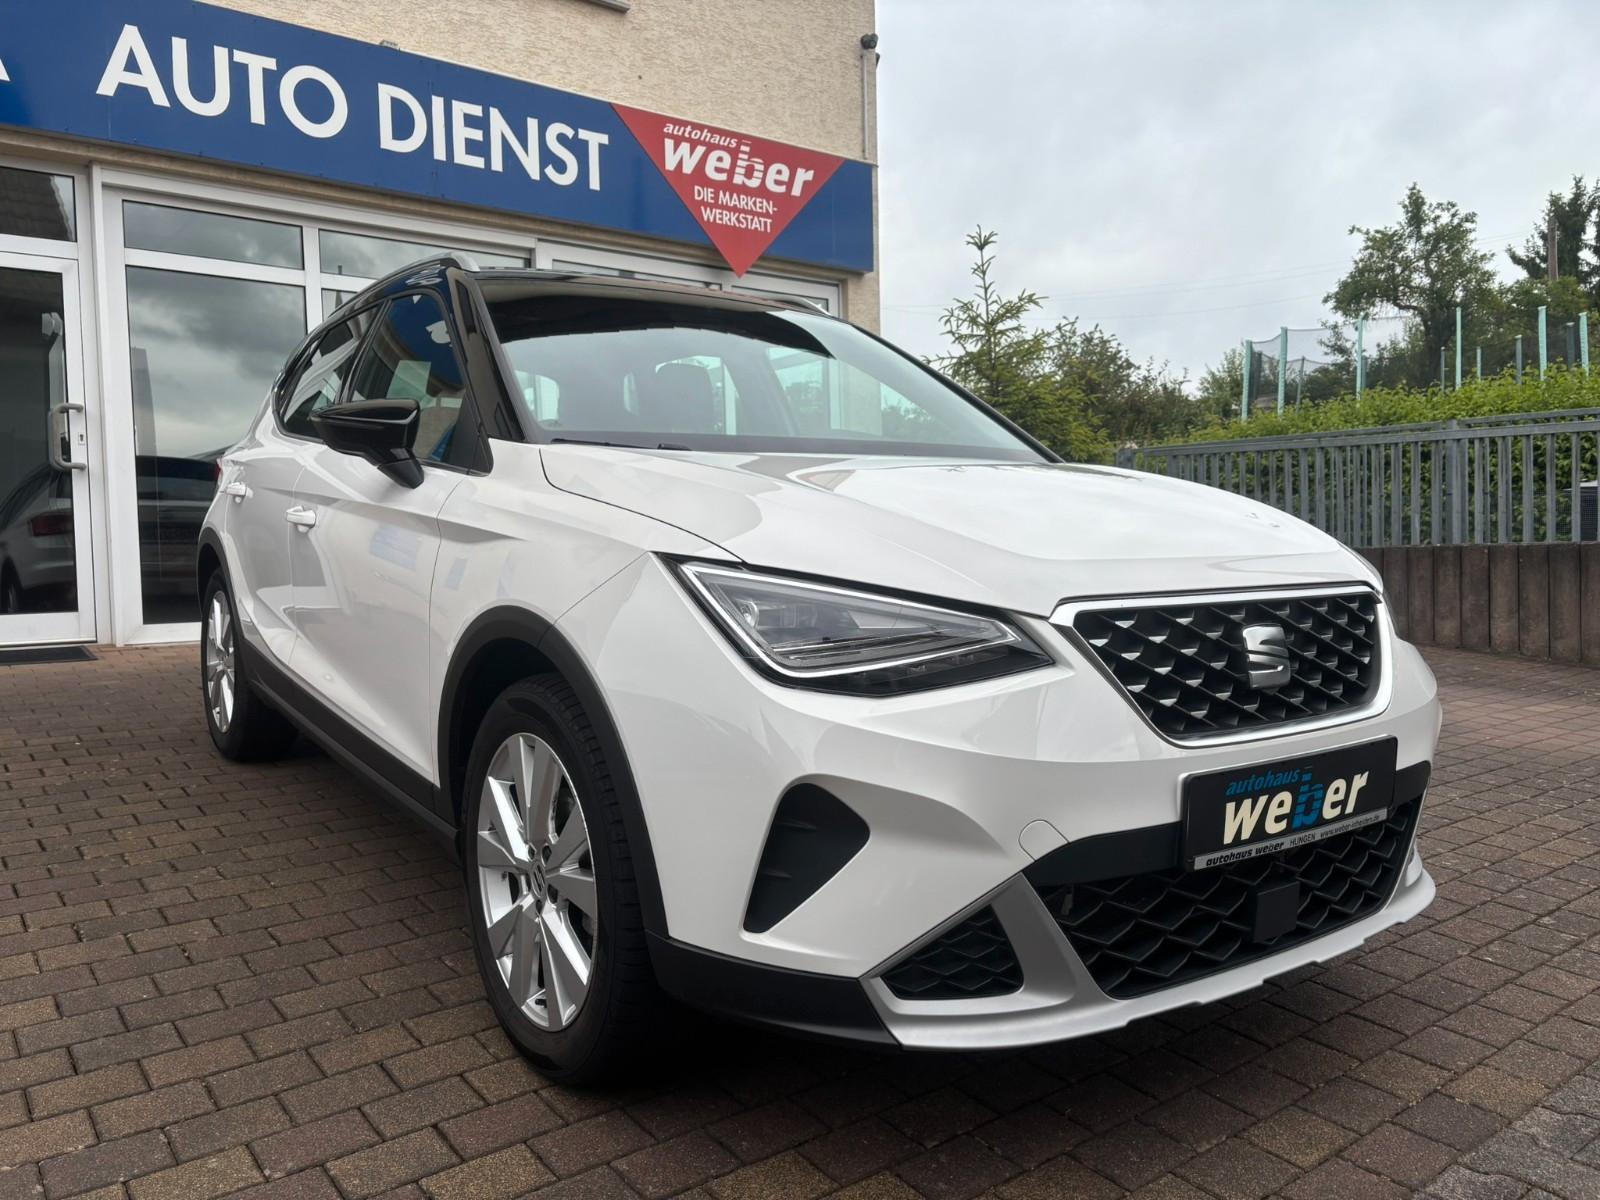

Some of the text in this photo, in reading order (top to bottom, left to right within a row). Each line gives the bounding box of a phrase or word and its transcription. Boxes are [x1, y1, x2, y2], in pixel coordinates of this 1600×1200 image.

[96, 24, 609, 191] AUTO DIENST
[663, 122, 738, 149] autohaus
[664, 138, 814, 197] weber
[694, 185, 778, 214] DIE MARKEN-
[701, 206, 773, 233] WERKSTATT
[1226, 768, 1301, 797] autohaus
[1223, 766, 1369, 845] weber
[1205, 848, 1253, 867] autohaus
[1255, 841, 1285, 855] weber
[1289, 832, 1316, 847] HUNGEN
